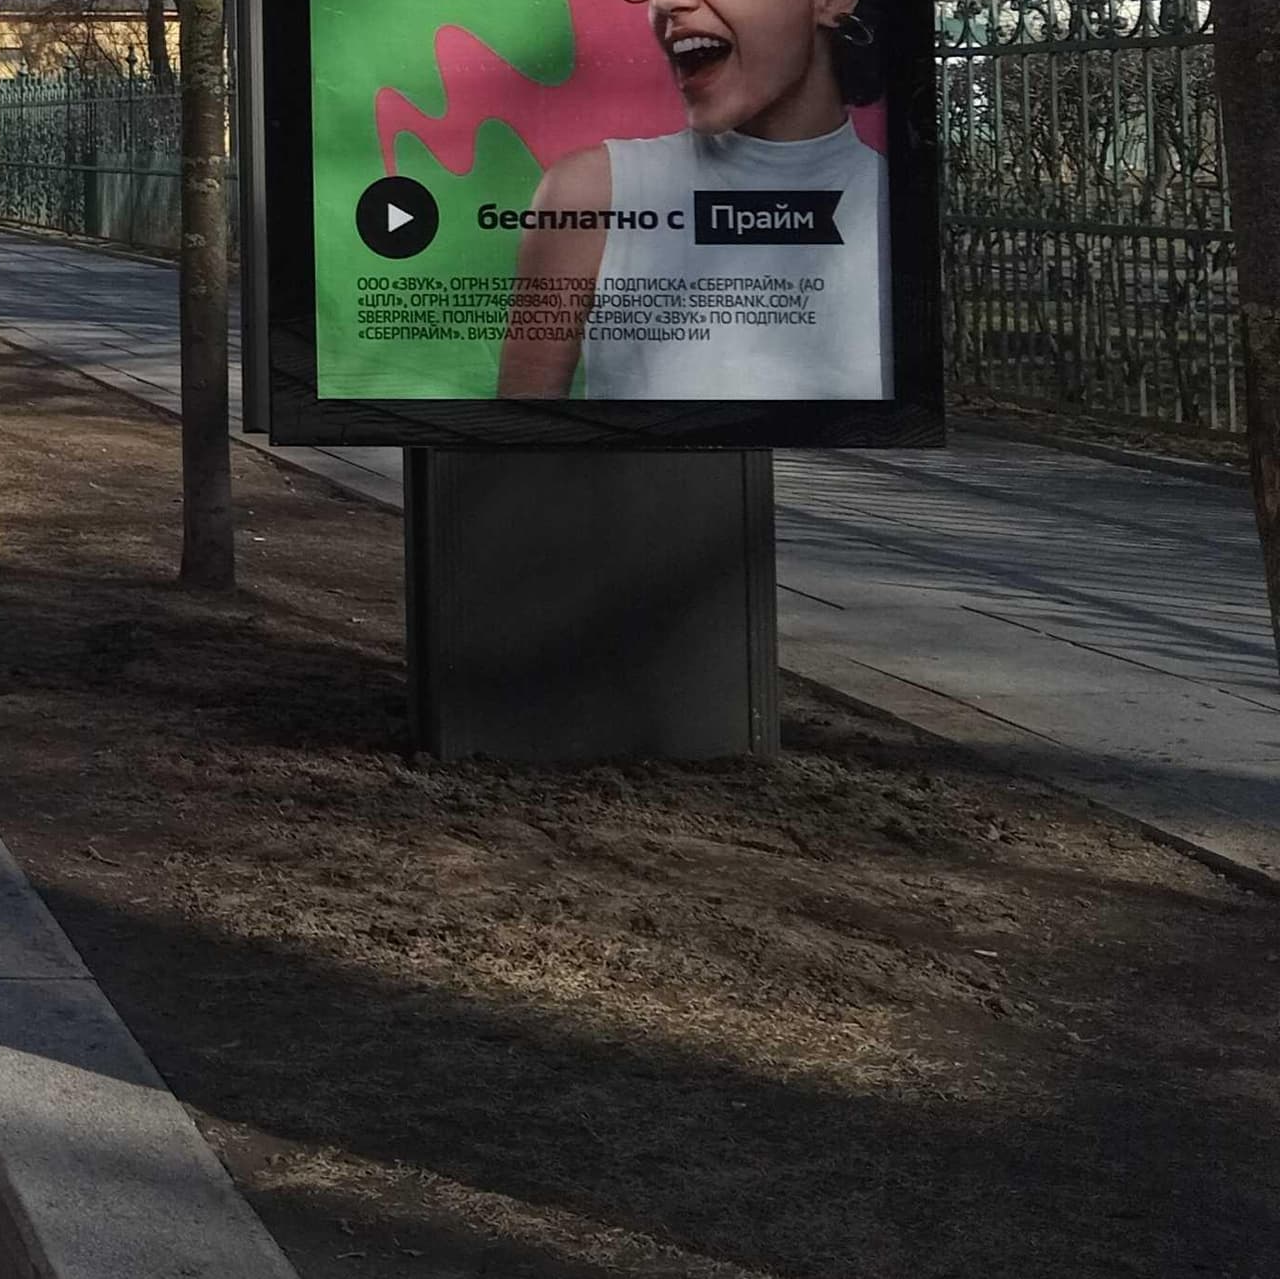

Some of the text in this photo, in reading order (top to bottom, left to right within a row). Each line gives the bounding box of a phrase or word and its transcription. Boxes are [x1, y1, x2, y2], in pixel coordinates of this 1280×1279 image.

[477, 203, 685, 231] бесплатно с
[711, 203, 814, 235] Прайм
[357, 278, 390, 291] ООО
[392, 278, 447, 293] «ЗВУК»,
[450, 278, 492, 291] ОГРН
[604, 278, 687, 293] ПОДПИСКА
[690, 274, 794, 291] «СБЕРПРАЙМ»
[799, 278, 824, 294] (АО
[358, 294, 408, 309] «ЦПЛ»,
[410, 294, 450, 307] ОГРН
[570, 294, 687, 309] ПОДРОБНОСТИ:
[689, 295, 810, 310] SBERBANK.COM/
[358, 307, 817, 326] SBERPRIME. ПОЛНЫЙ ДОСТУП К СЕРВИСУ «ЗВУК» ПО ПОДПИСКЕ
[358, 324, 711, 343] «СБЕРПРАЙМ». ВИЗУАЛ СОЗДАН С ПОМОЩЬЮ ИИ
